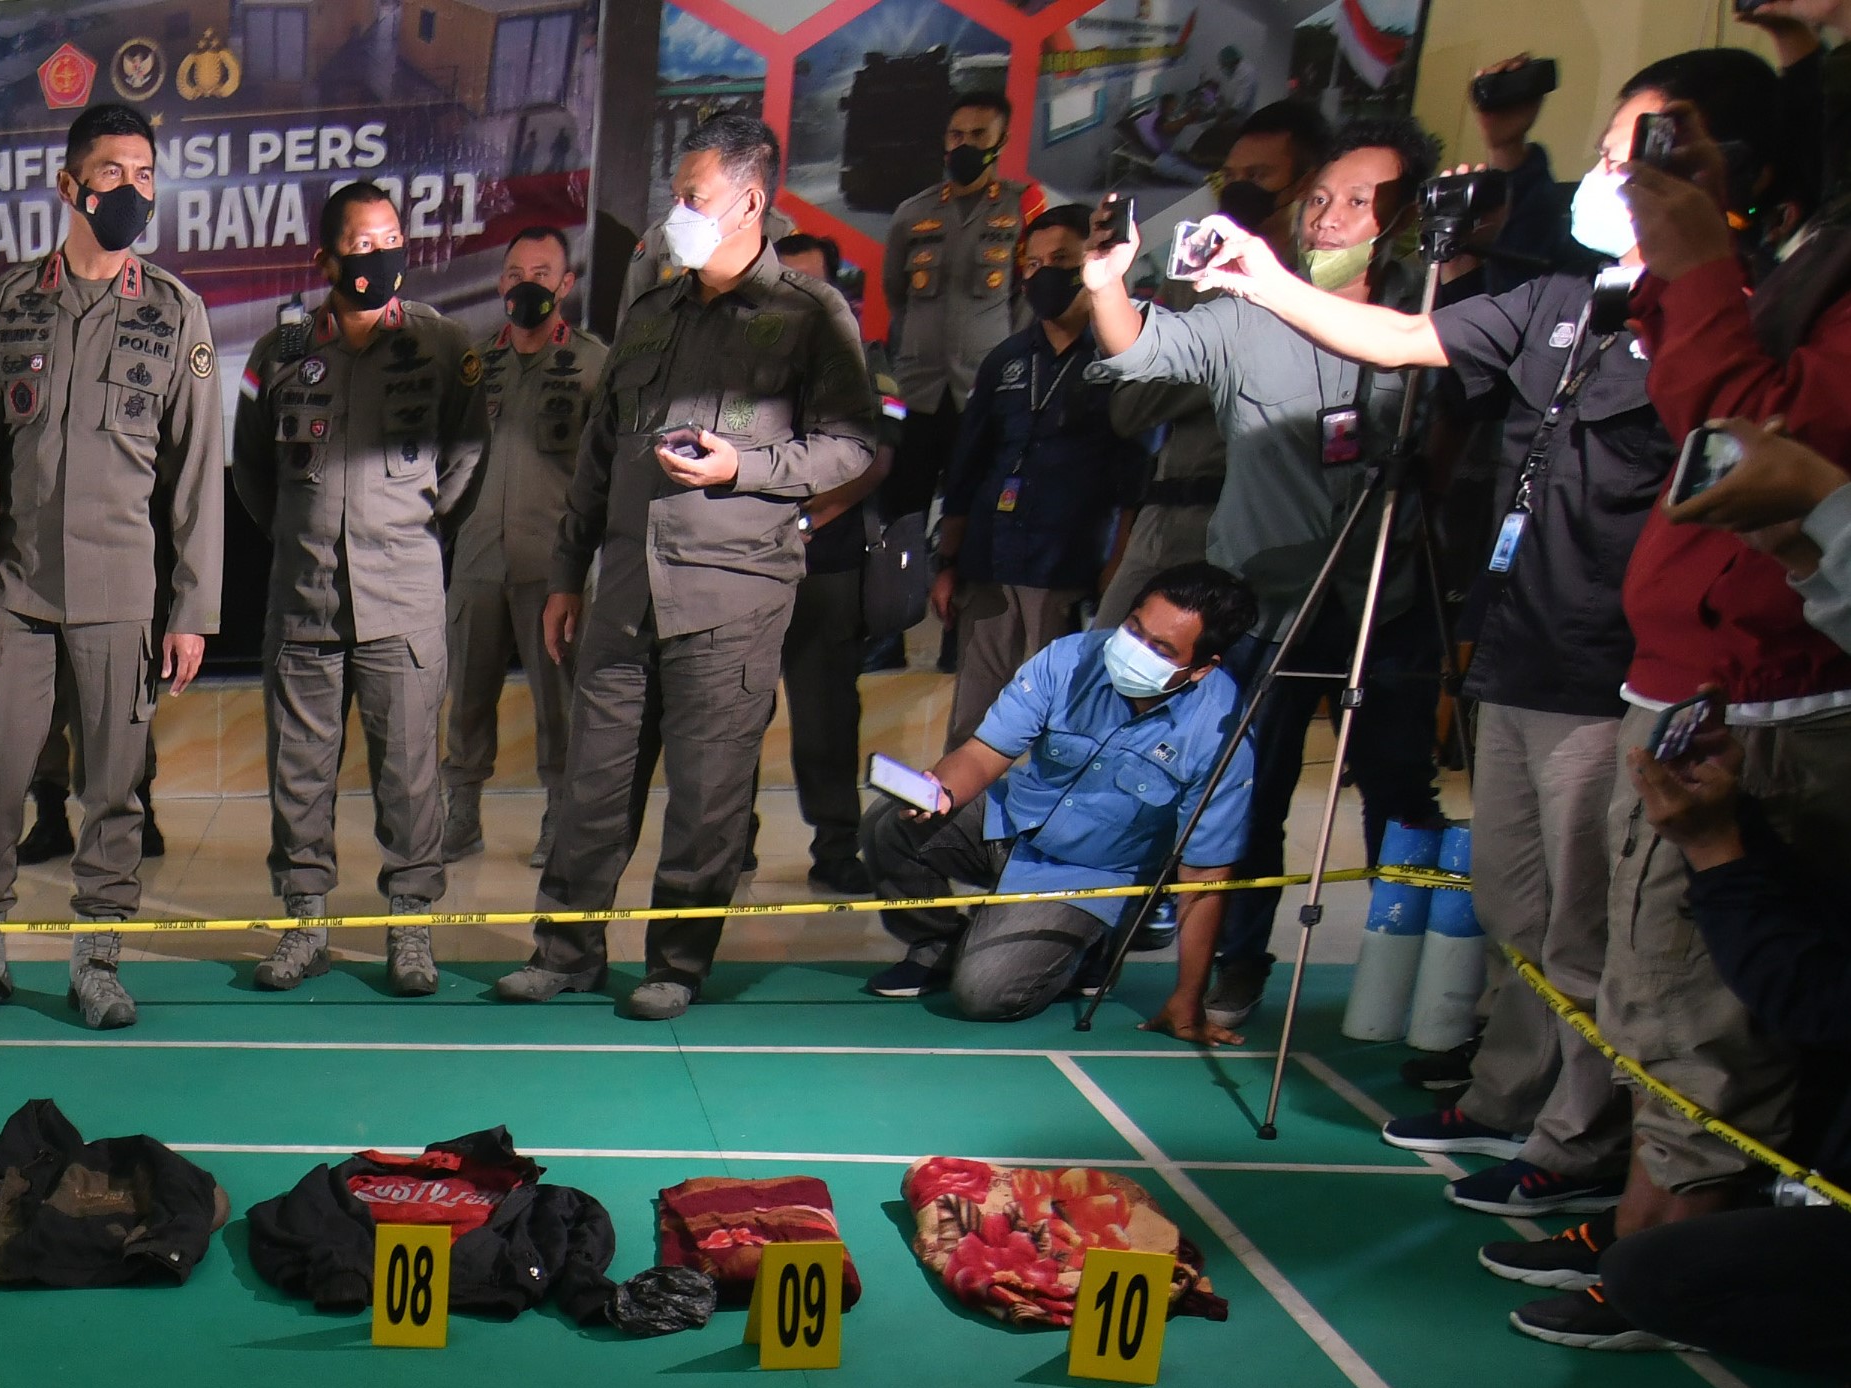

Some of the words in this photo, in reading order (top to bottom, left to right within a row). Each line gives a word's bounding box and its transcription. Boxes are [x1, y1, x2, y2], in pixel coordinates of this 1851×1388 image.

[248, 122, 387, 175] PERS
[177, 183, 310, 252] RAYA
[118, 335, 170, 359] POLRI
[387, 1244, 433, 1326] 08
[778, 1263, 826, 1347] 09
[1095, 1272, 1148, 1360] 10
